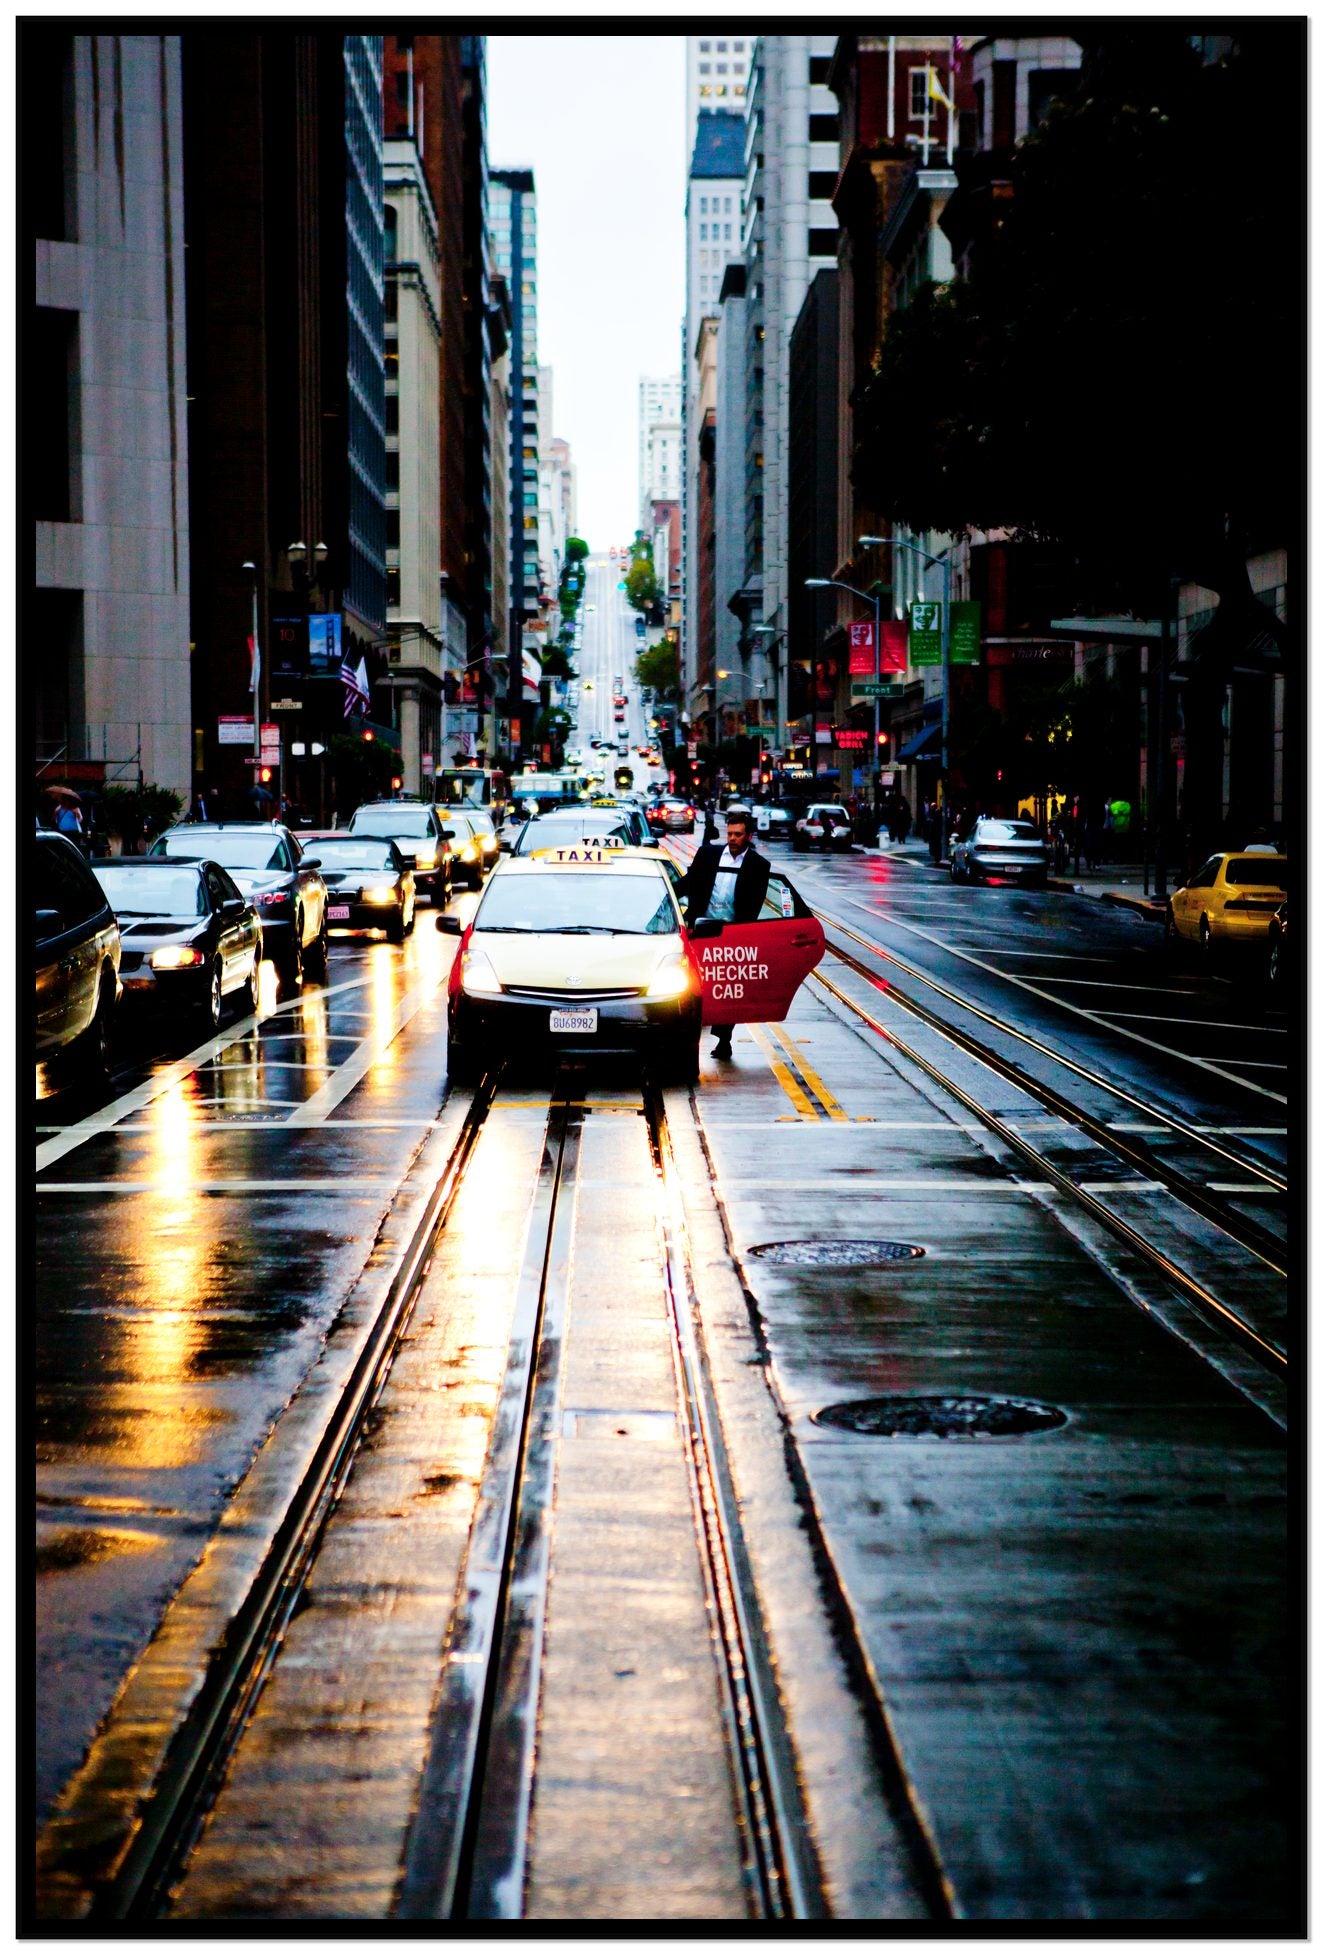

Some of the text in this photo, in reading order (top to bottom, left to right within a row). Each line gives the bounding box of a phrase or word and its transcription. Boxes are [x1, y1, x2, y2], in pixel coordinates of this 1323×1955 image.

[865, 686, 891, 694] Front
[835, 731, 868, 740] TADICH
[838, 740, 863, 749] GRILL
[582, 838, 619, 847] TAXI
[556, 850, 602, 862] TAXI
[702, 946, 759, 963] ARROW
[712, 983, 744, 1000] CAB
[553, 1017, 594, 1029] 8U68982
